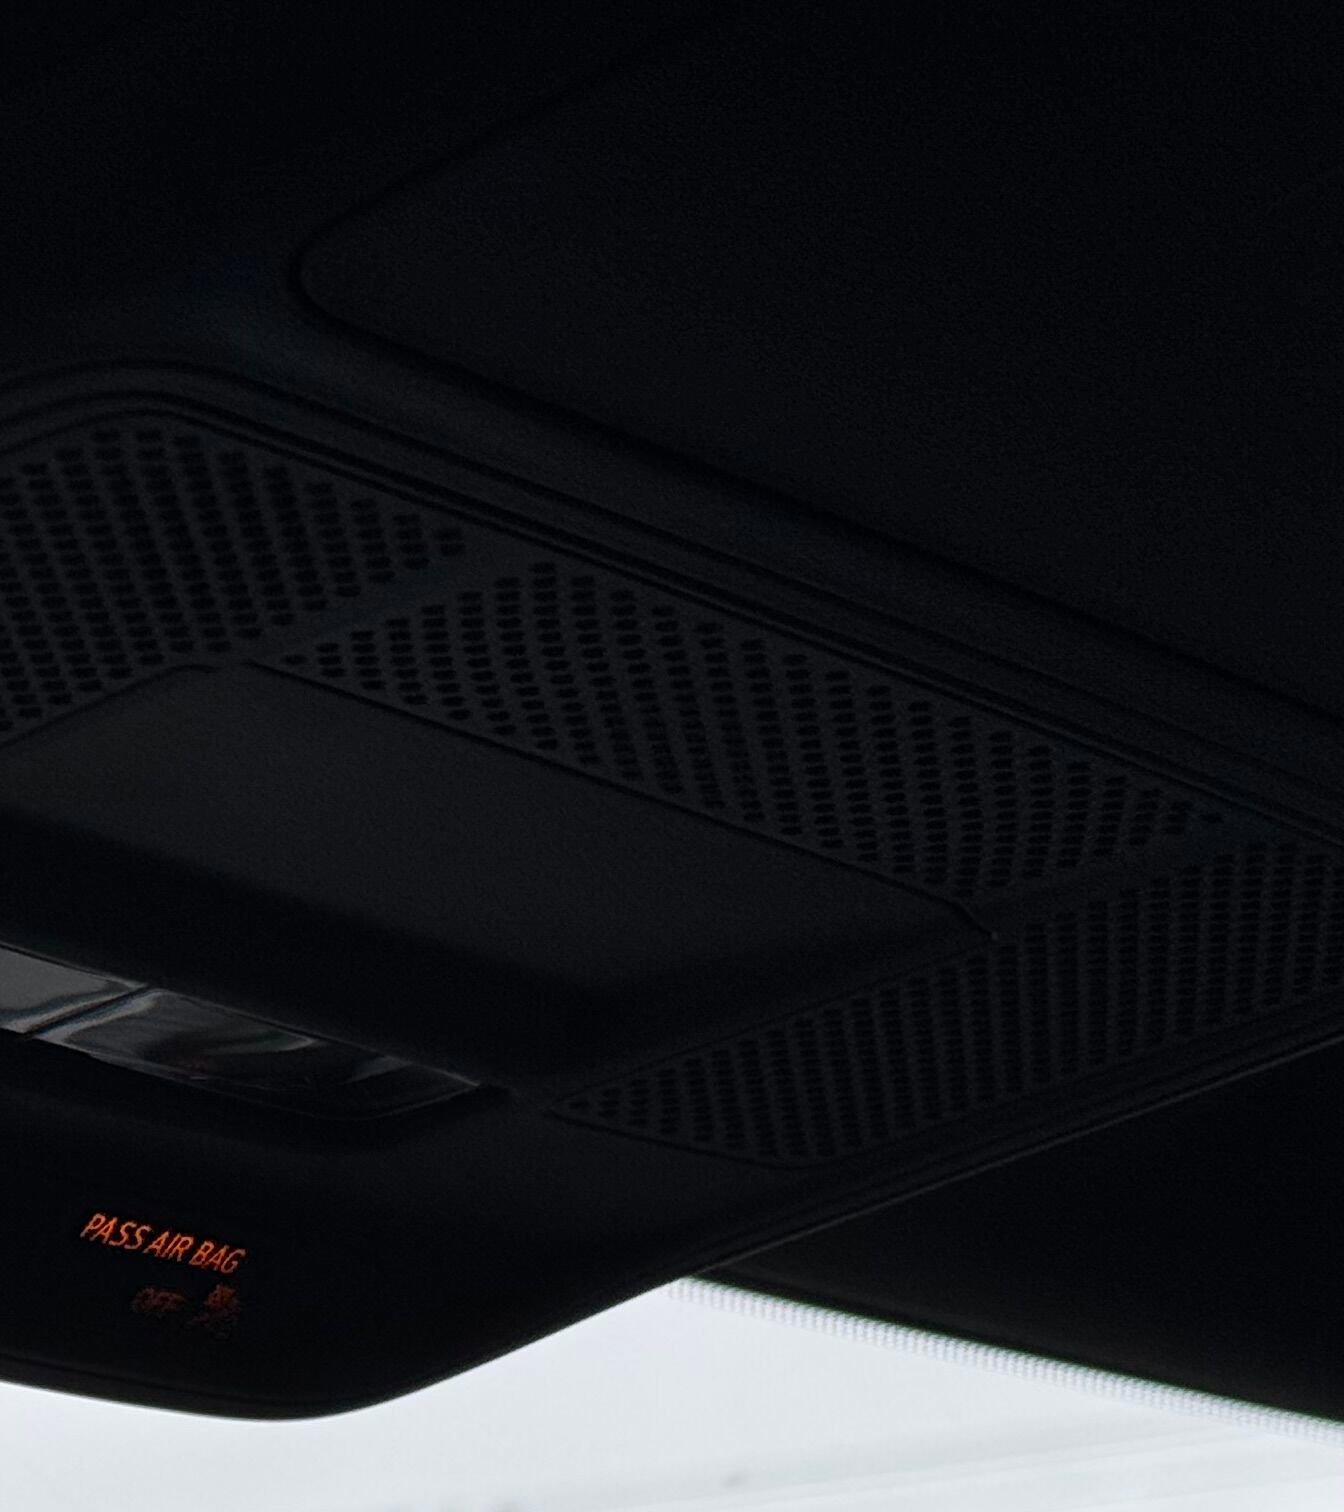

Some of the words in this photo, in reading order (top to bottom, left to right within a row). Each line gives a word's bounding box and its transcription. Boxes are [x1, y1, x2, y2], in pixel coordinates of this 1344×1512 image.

[80, 1212, 153, 1251] PASS
[143, 1230, 194, 1263] AIR
[188, 1240, 247, 1275] BAG
